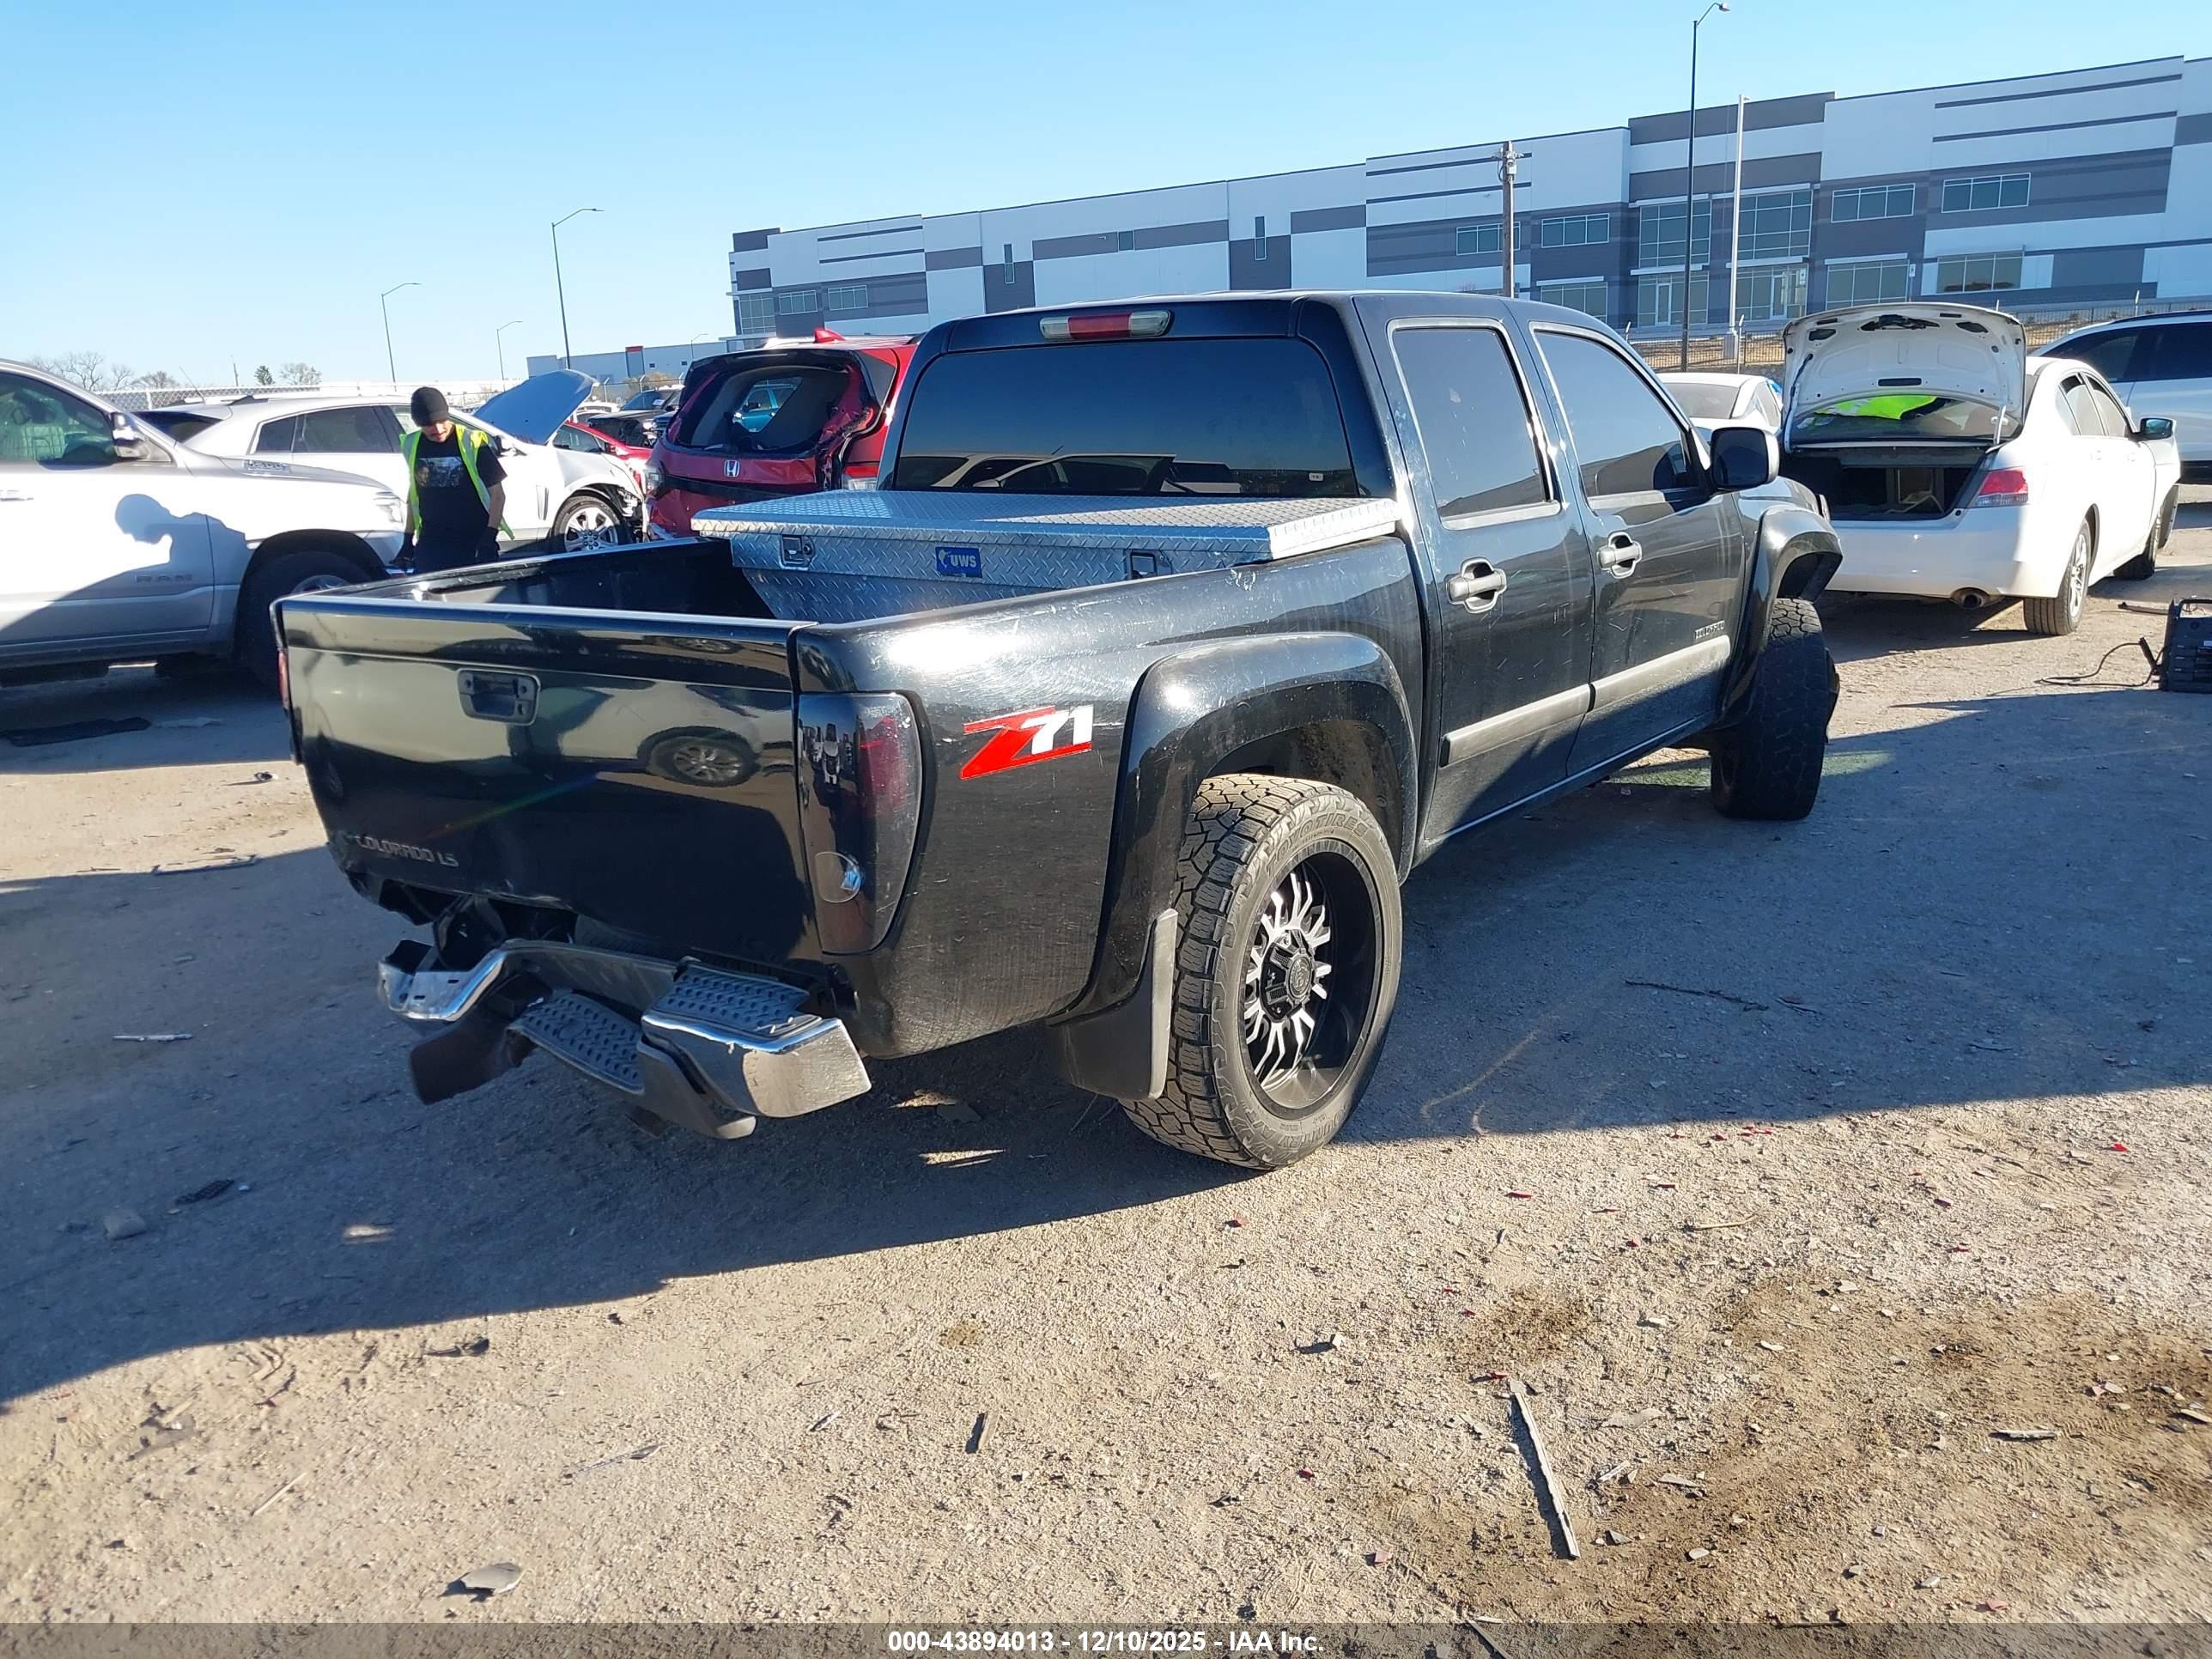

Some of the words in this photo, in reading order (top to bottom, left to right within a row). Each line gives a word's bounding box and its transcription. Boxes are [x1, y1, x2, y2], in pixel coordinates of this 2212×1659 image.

[950, 555, 977, 568] UWS
[960, 704, 1094, 781] Z71
[1315, 811, 1370, 838] TIRES
[353, 835, 434, 863] COLORADO
[436, 851, 459, 867] LS
